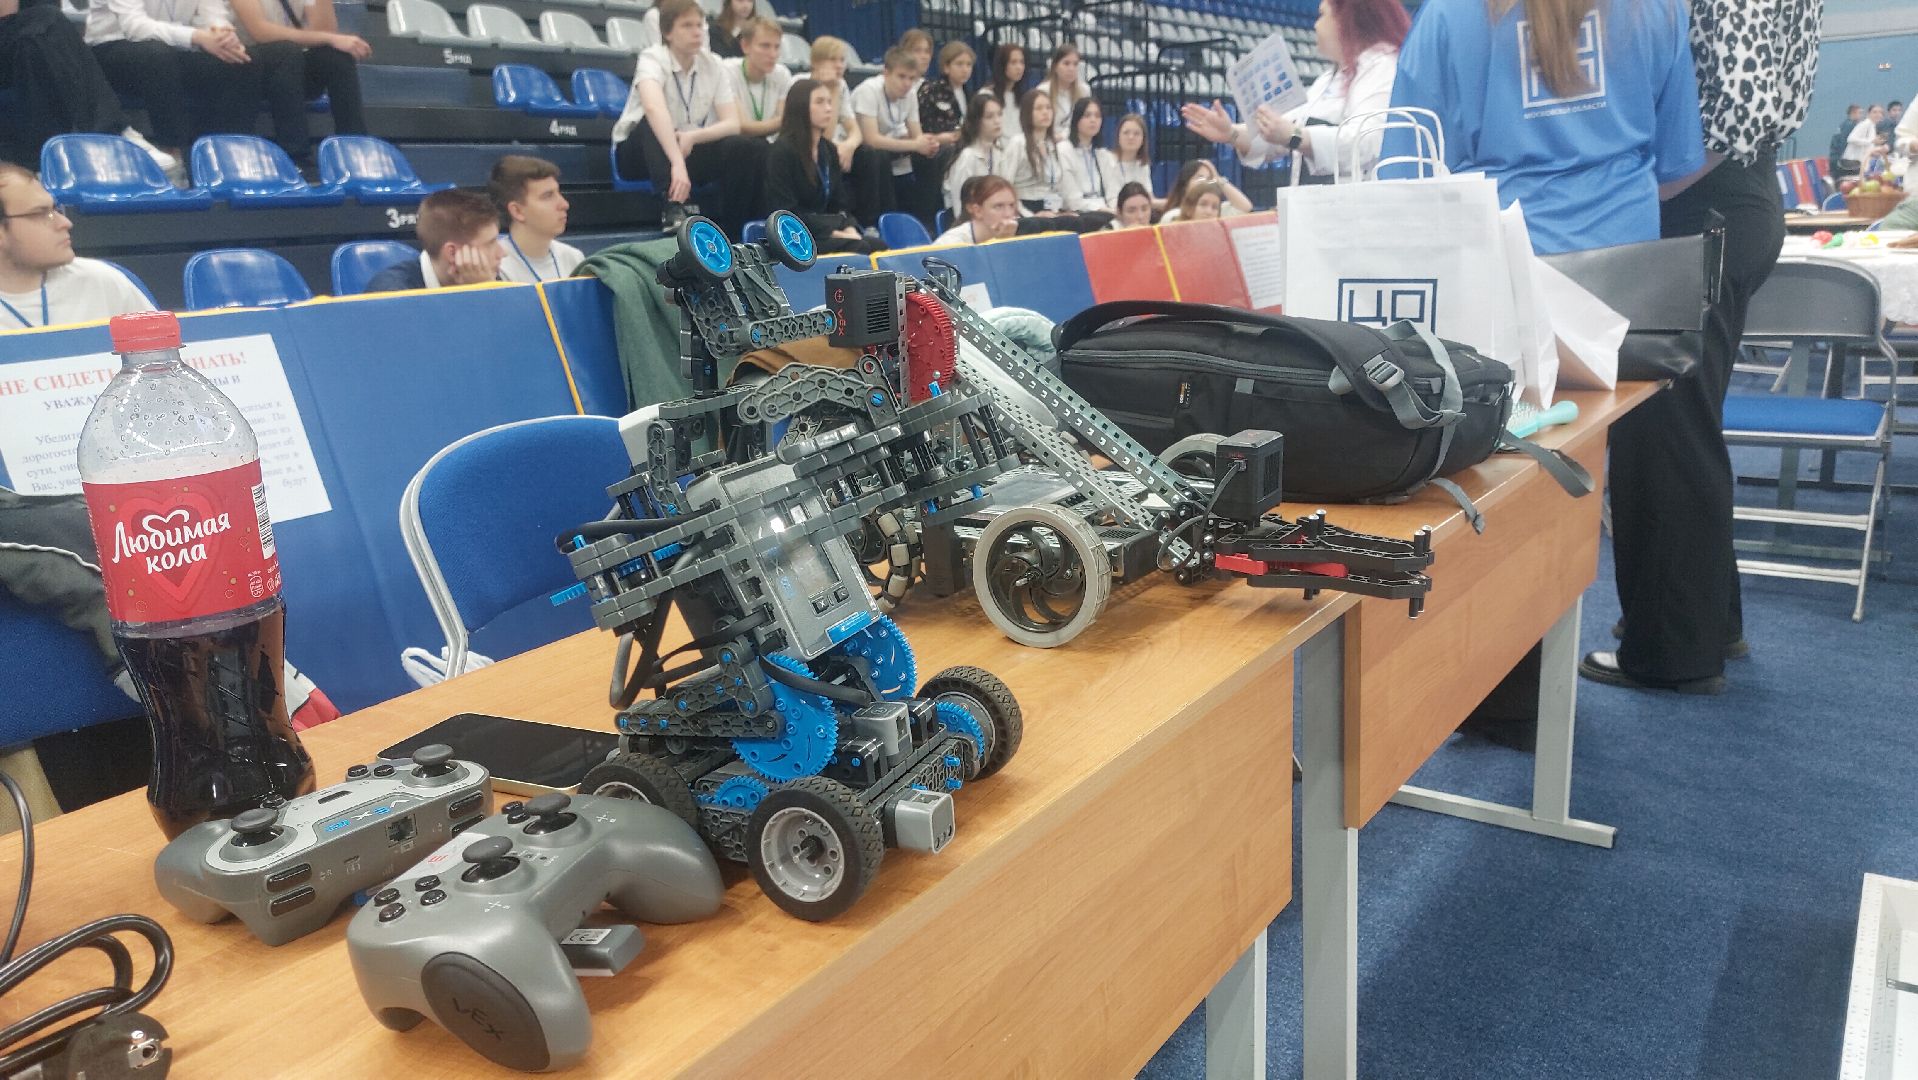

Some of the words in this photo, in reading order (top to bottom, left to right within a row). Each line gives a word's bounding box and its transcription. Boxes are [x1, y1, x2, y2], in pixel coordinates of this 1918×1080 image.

[837, 308, 846, 337] VEX
[186, 351, 247, 370] НАТЬ!
[112, 509, 231, 563] Любимая
[146, 543, 207, 575] кола
[452, 997, 504, 1041] VEX
